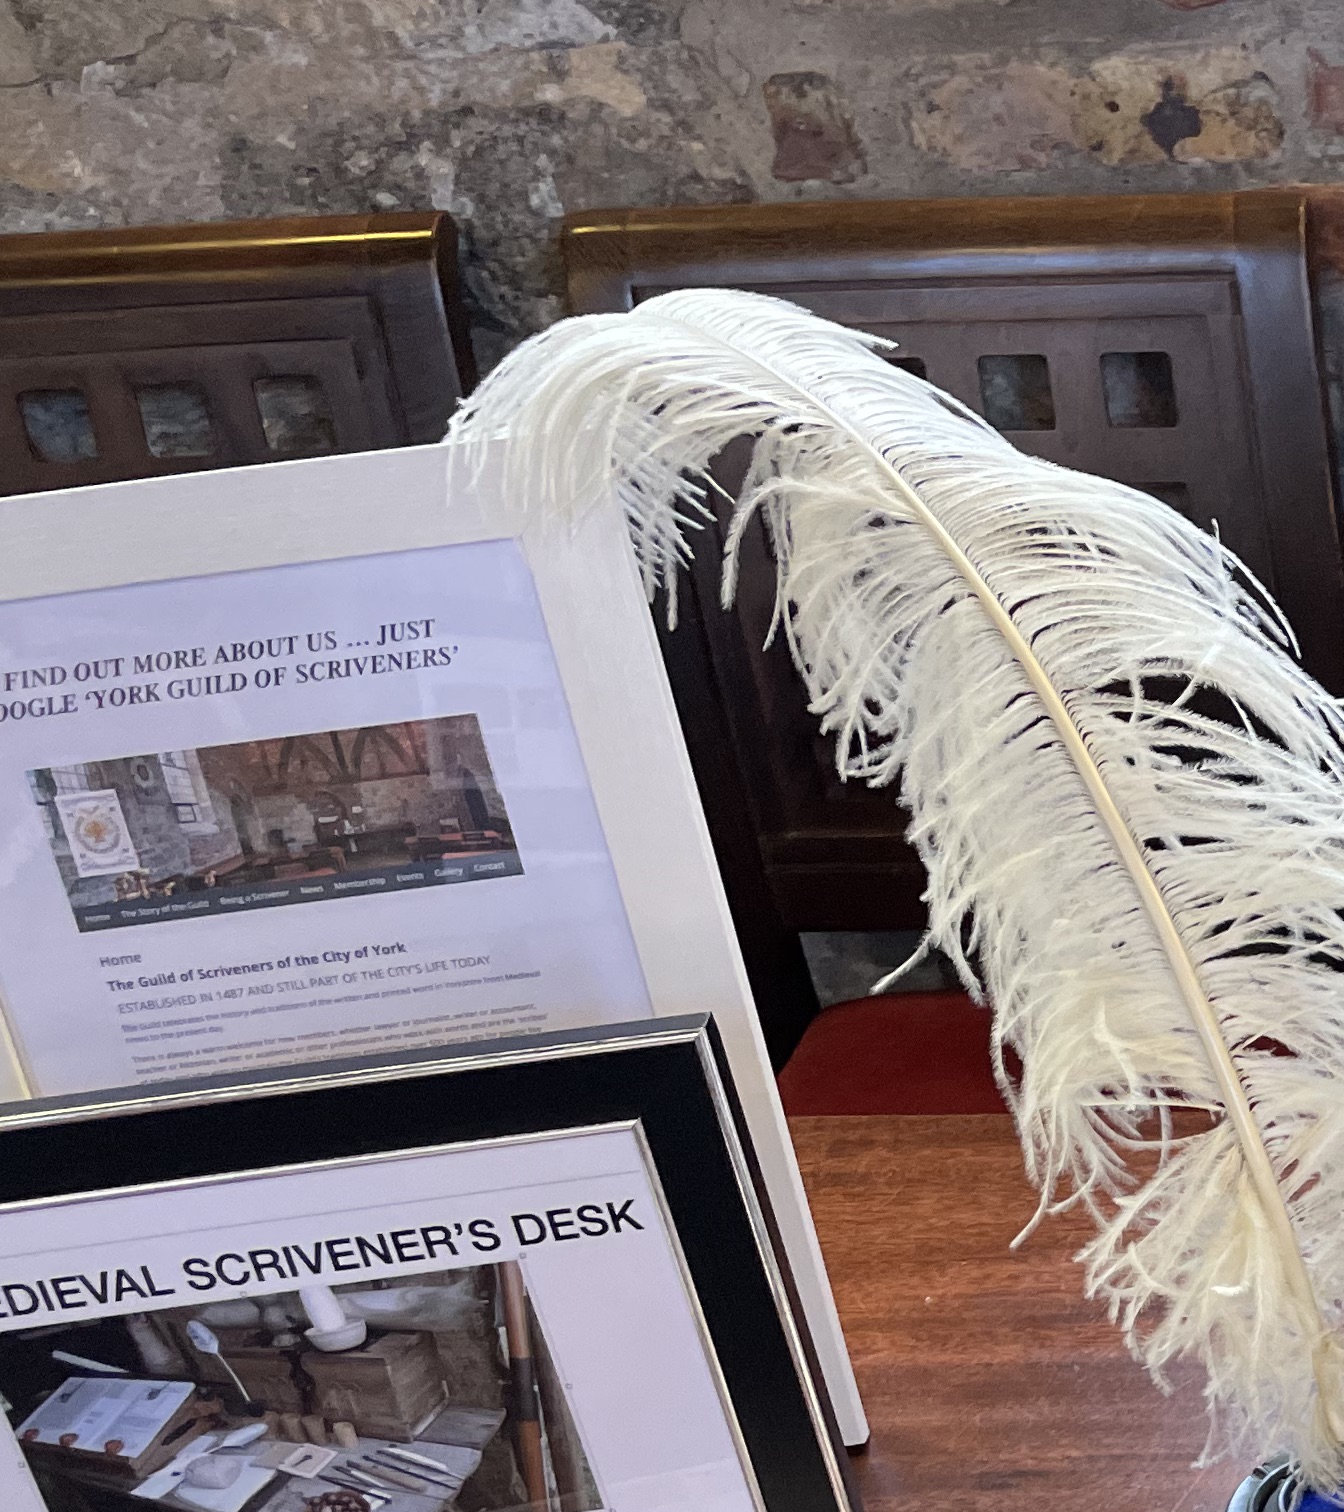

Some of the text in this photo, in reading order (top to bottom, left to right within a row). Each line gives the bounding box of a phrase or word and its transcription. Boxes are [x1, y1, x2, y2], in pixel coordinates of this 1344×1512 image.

[4, 618, 436, 692] FIND OUT MORE ABOUT US JUST
[166, 672, 248, 700] GUILD
[254, 666, 287, 689] OF
[105, 941, 407, 992] The Guild of Scriveners of the City of York
[117, 994, 198, 1015] ESTABLISHED
[199, 992, 214, 1003] IN
[215, 987, 244, 1001] 1487
[247, 983, 275, 997] AND
[276, 979, 309, 993] STILL
[309, 974, 339, 988] PART
[341, 971, 358, 984] OF
[359, 968, 385, 981] THE
[424, 960, 449, 974] LIFE
[449, 955, 490, 969] TODAY
[0, 1265, 176, 1318] DIEVAL
[510, 1199, 645, 1246] DESK
